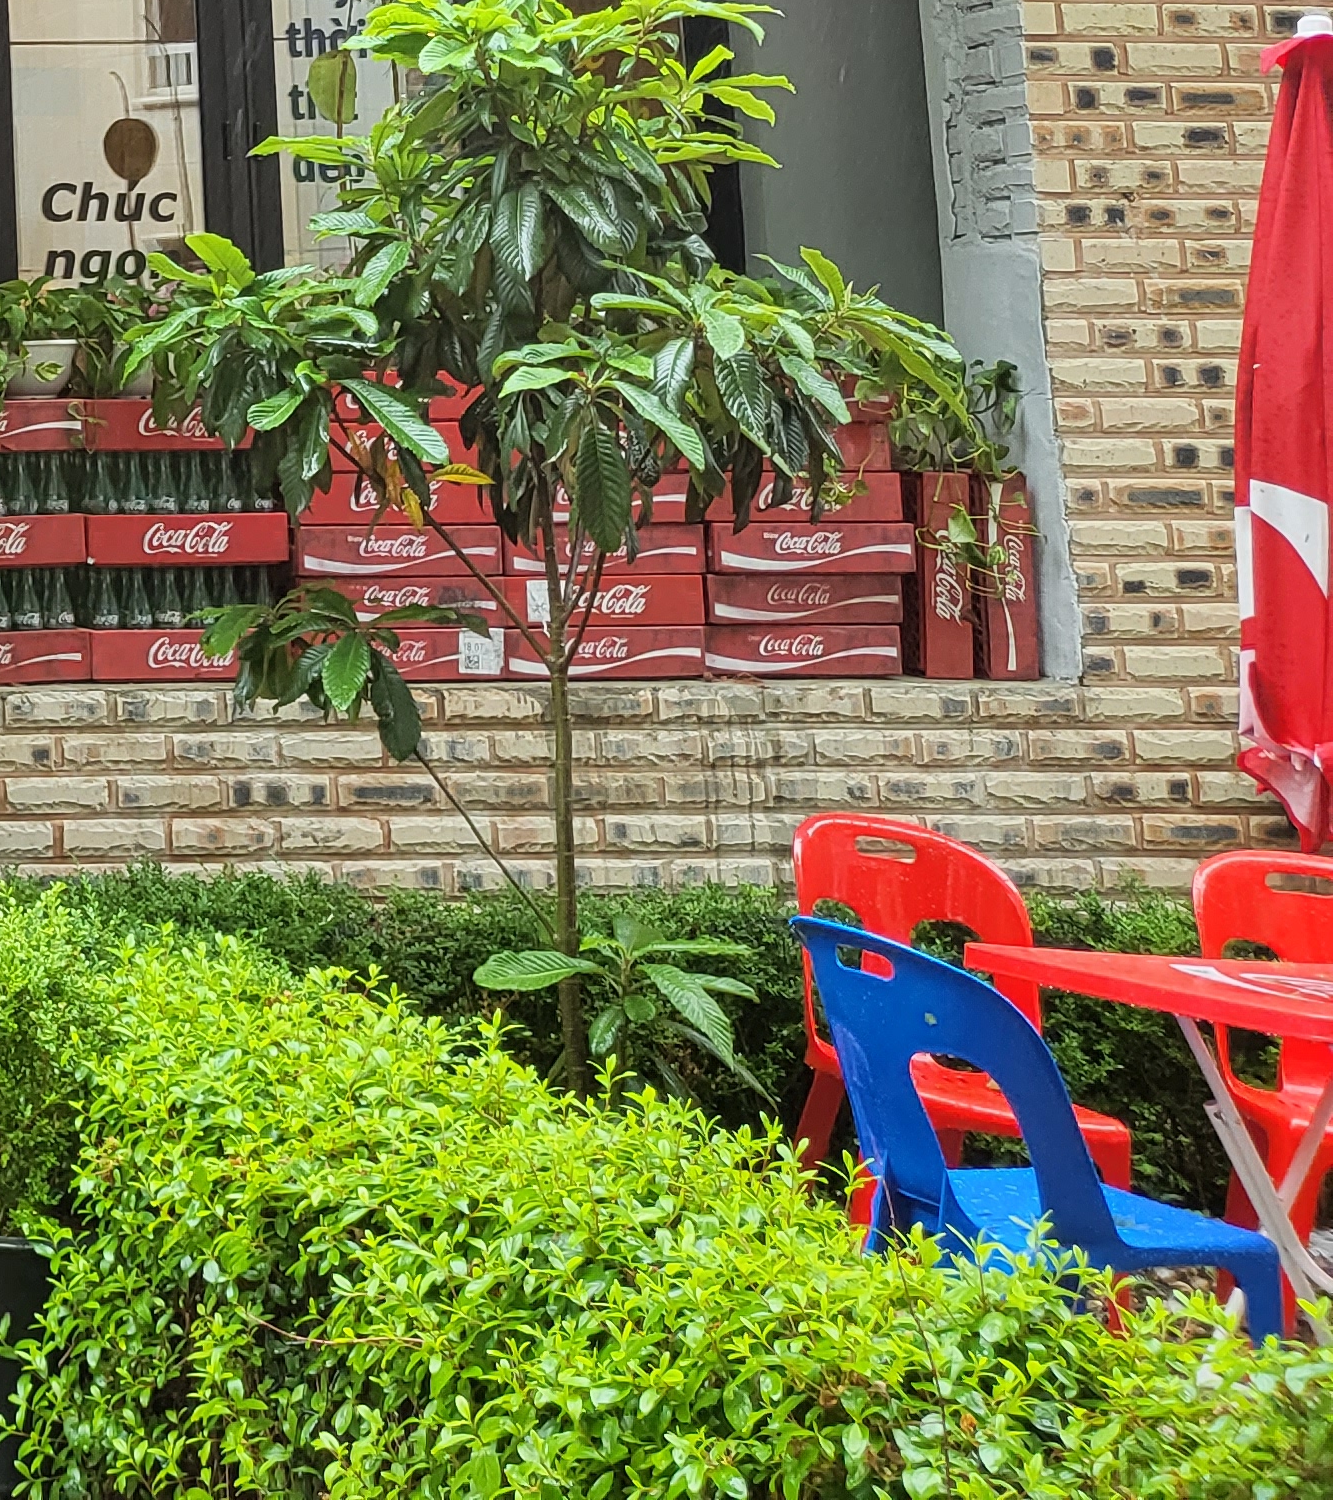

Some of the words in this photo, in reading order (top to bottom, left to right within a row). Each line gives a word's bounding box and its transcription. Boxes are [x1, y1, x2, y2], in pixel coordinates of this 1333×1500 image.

[44, 248, 169, 289] ngo
[143, 521, 233, 555] Coca-Cola
[775, 532, 844, 554] Coca-Cola
[759, 634, 825, 656] Coca-Cola
